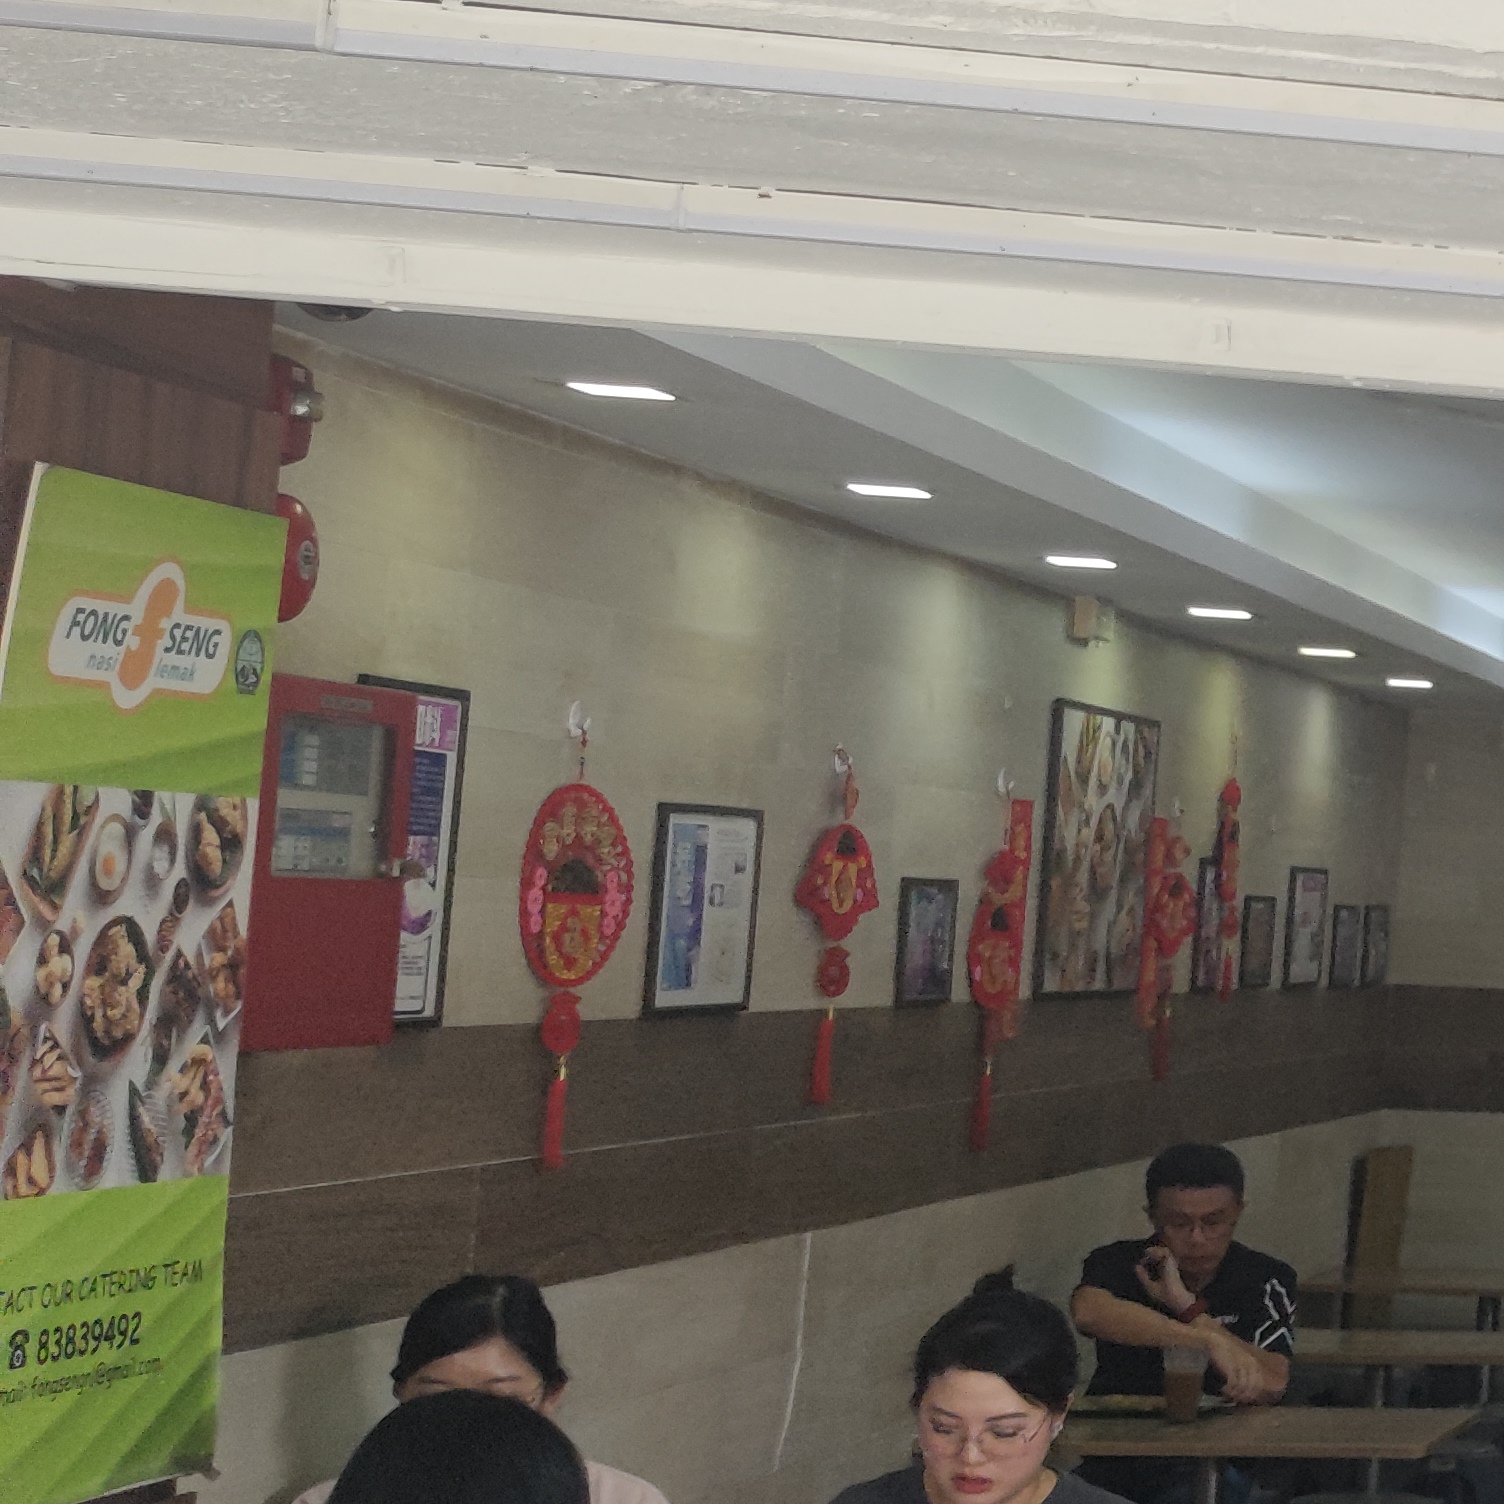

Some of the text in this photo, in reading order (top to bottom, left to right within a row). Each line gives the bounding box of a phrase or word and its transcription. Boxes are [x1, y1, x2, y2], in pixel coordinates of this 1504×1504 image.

[65, 607, 222, 660] FONG SENG
[86, 652, 197, 682] nasi lemak
[41, 1279, 74, 1308] OUR
[79, 1264, 157, 1301] CATERING
[162, 1258, 203, 1288] TEAM
[37, 1311, 143, 1366] 83839492
